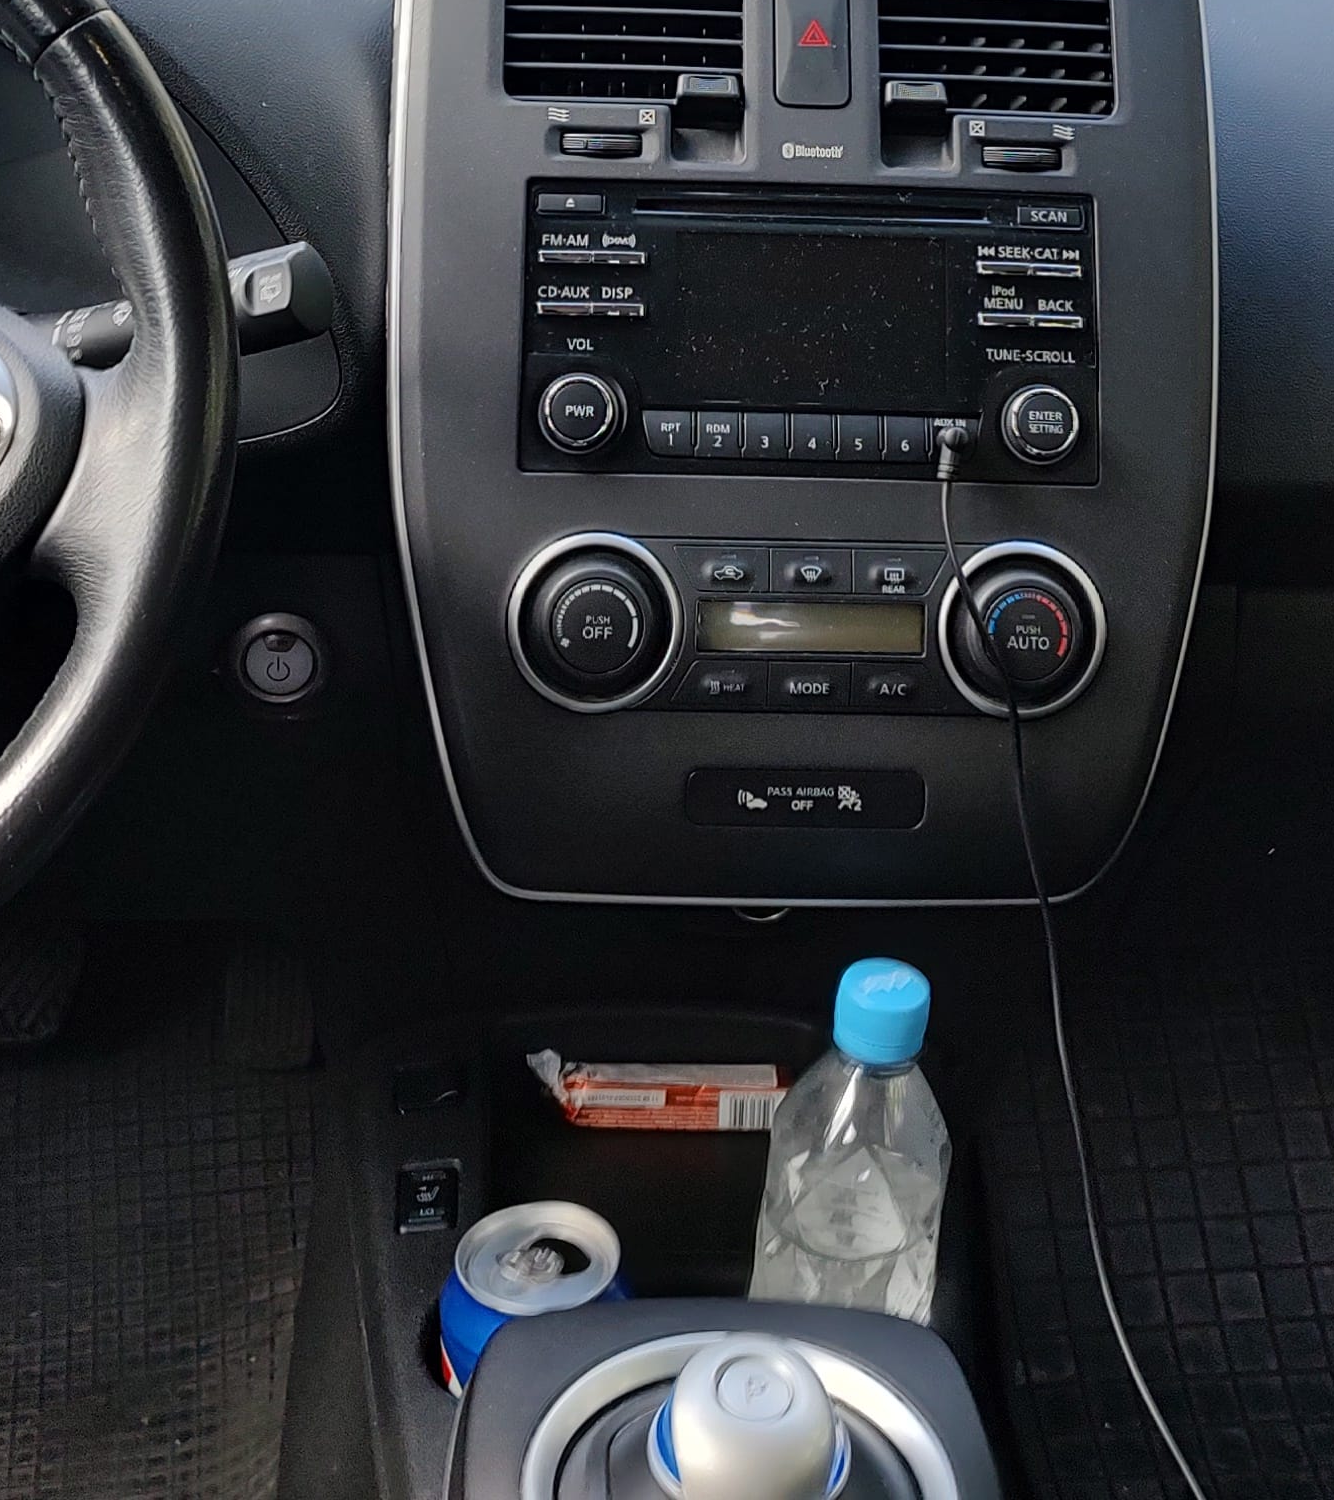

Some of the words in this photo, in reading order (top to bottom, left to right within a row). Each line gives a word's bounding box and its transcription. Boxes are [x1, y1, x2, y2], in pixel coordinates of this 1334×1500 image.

[795, 144, 843, 158] Bluetooth
[1030, 210, 1067, 223] SCAN
[601, 286, 633, 299] DISP
[991, 285, 1015, 296] iPod
[983, 297, 1024, 310] MENU
[1037, 299, 1074, 312] BACK
[567, 338, 594, 351] VOL
[565, 404, 594, 418] PWR
[1028, 411, 1064, 421] ENTER
[660, 422, 681, 433] RPT
[706, 423, 731, 434] RDM
[934, 417, 954, 427] AUX
[1028, 423, 1064, 434] SETTING
[668, 433, 673, 447] 1
[713, 435, 723, 448] 2
[760, 436, 769, 449] 3
[807, 437, 817, 450] 4
[855, 437, 863, 451] 5
[901, 439, 910, 452] 6
[882, 584, 906, 594] REAR
[585, 615, 611, 625] PUSH
[582, 626, 613, 640] OFF
[1015, 625, 1041, 635] PUSH
[1007, 636, 1050, 650] AUTO
[789, 682, 830, 695] MODE
[879, 683, 907, 696] A/C
[767, 786, 793, 797] PASS
[795, 786, 835, 798] AIRBAG
[791, 799, 814, 811] OFF
